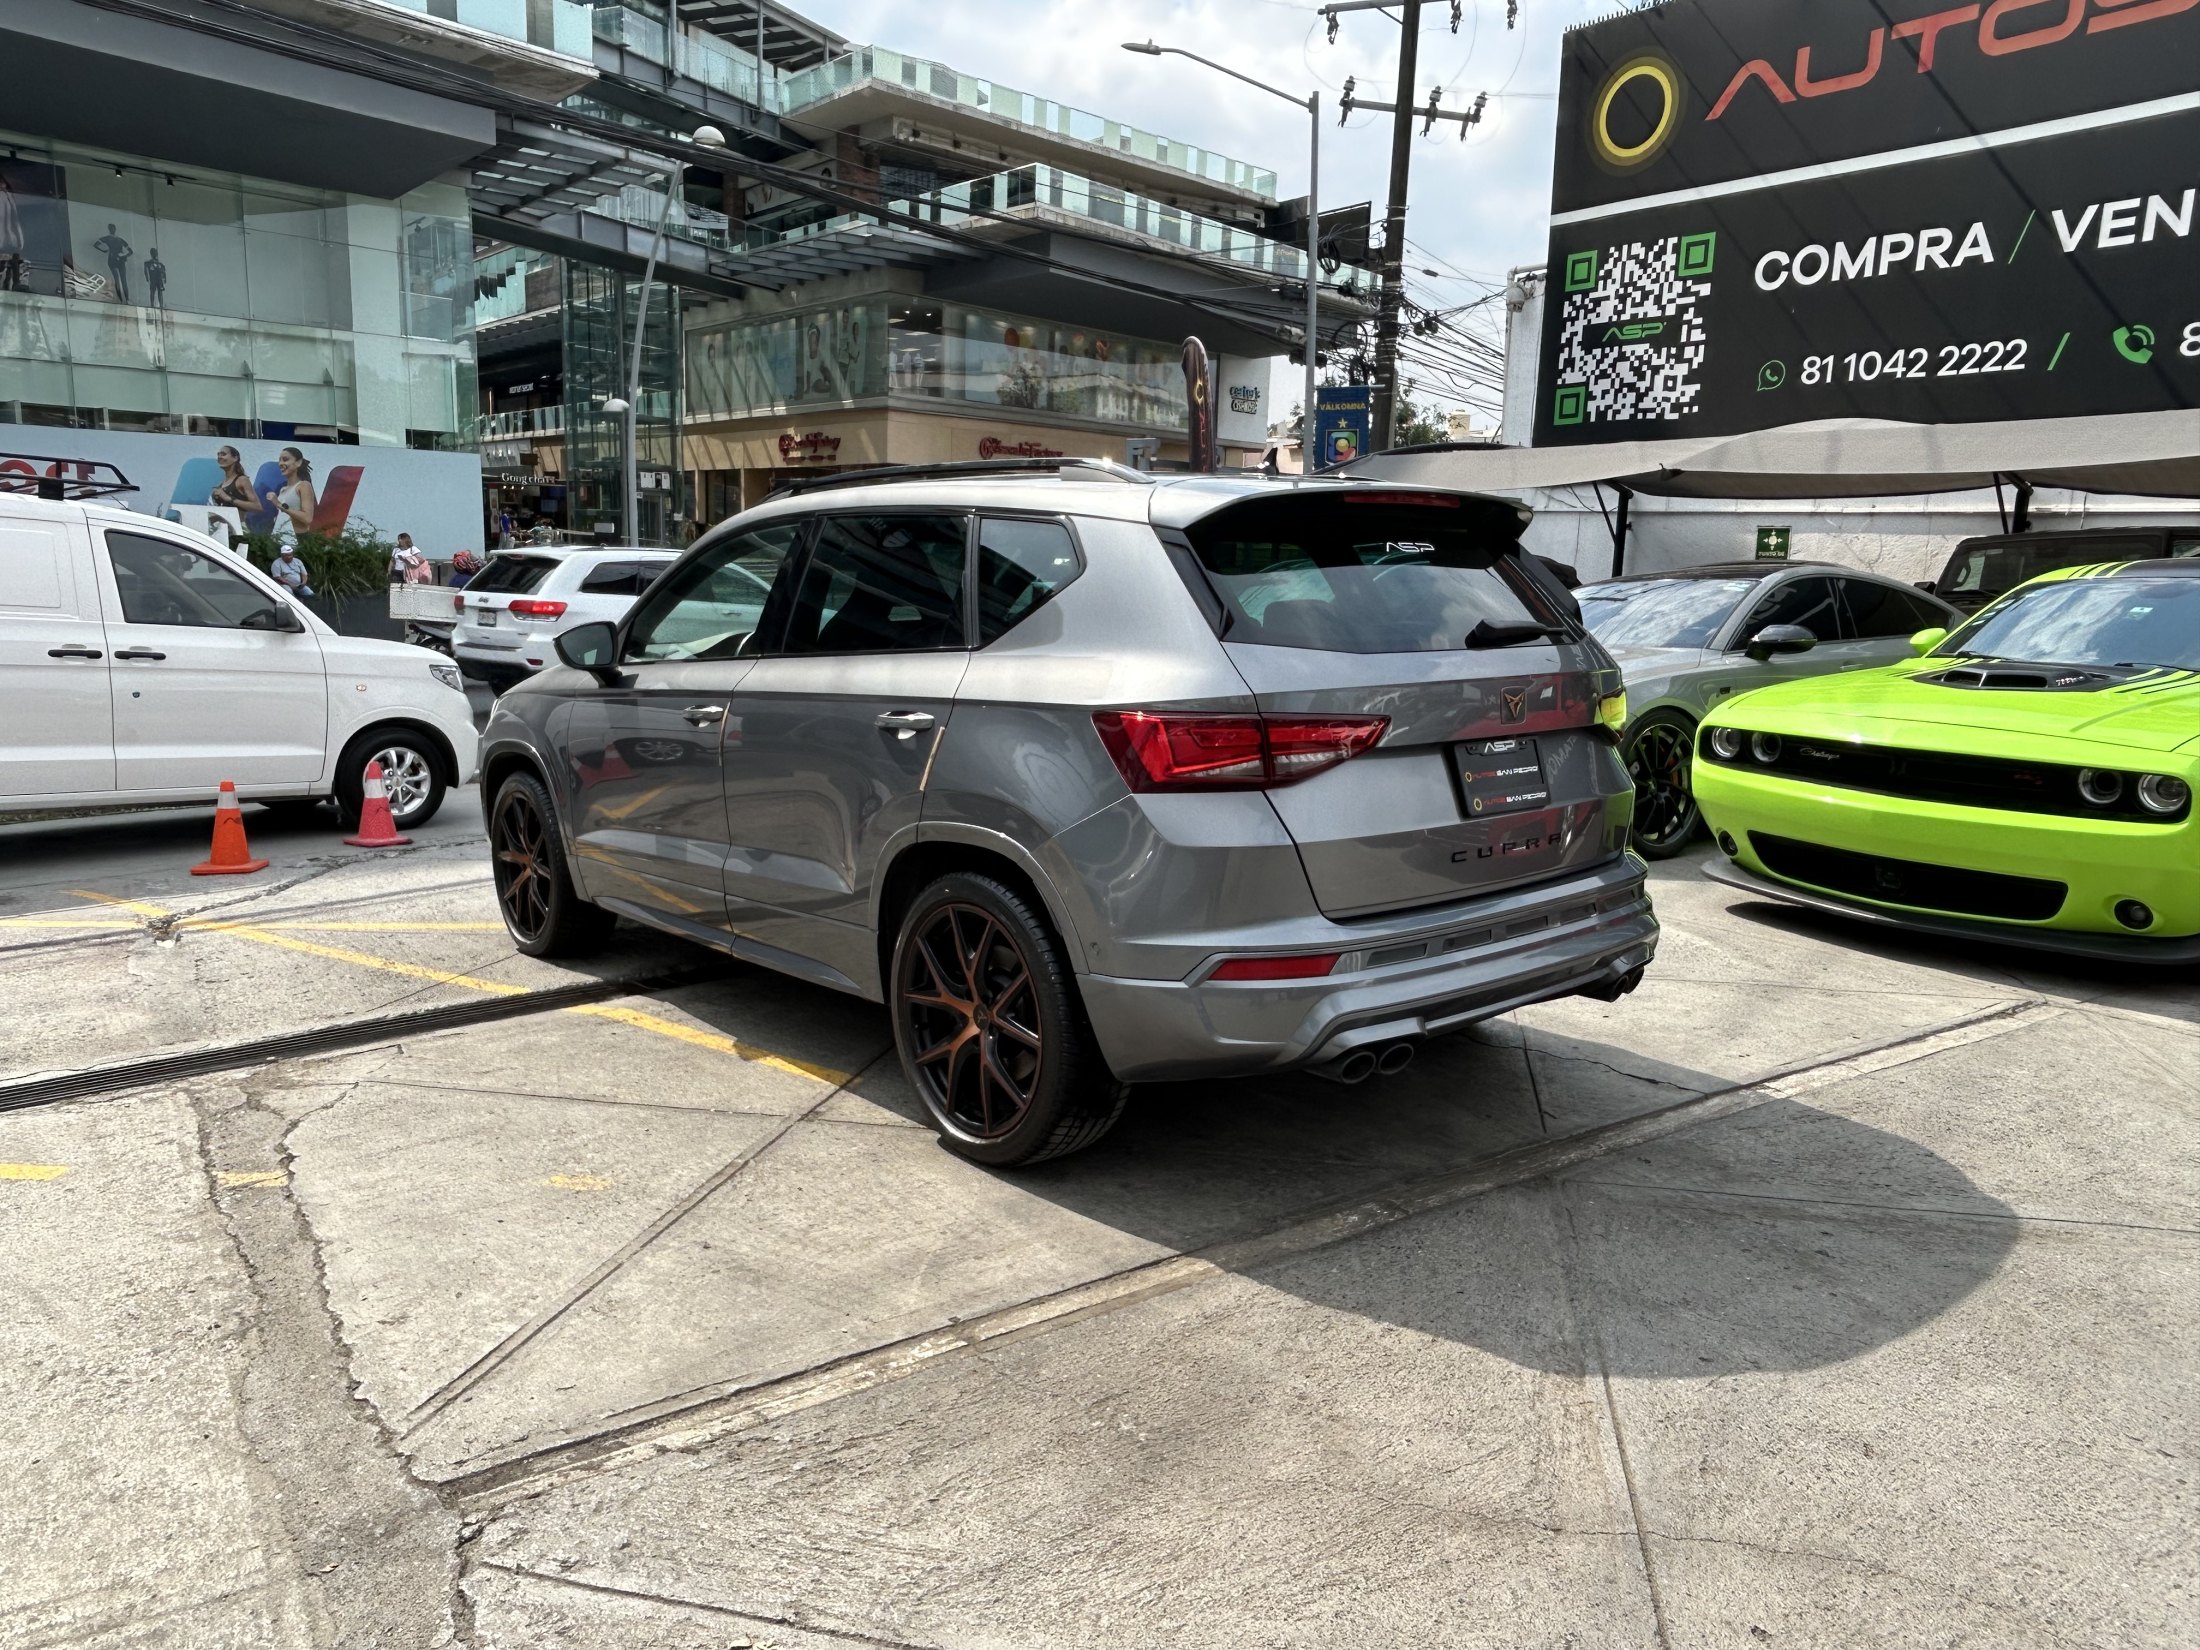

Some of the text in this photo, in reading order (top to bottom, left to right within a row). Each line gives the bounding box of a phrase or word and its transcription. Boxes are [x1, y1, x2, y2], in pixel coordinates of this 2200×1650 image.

[1754, 221, 1995, 291] COMPRA
[2051, 188, 2196, 254] VEN
[1602, 322, 1664, 342] ASP
[1800, 354, 1834, 385] 81
[1843, 347, 1928, 382] 1042
[1937, 338, 2028, 376] 2222
[501, 472, 528, 485] Gong
[1386, 541, 1435, 553] ASP
[1483, 740, 1516, 753] ASP
[1496, 768, 1513, 777] SAN
[1513, 766, 1539, 774] PEDRO
[1506, 795, 1522, 803] SAN
[1522, 791, 1547, 800] PEDRO
[1451, 833, 1561, 864] CUPRA
